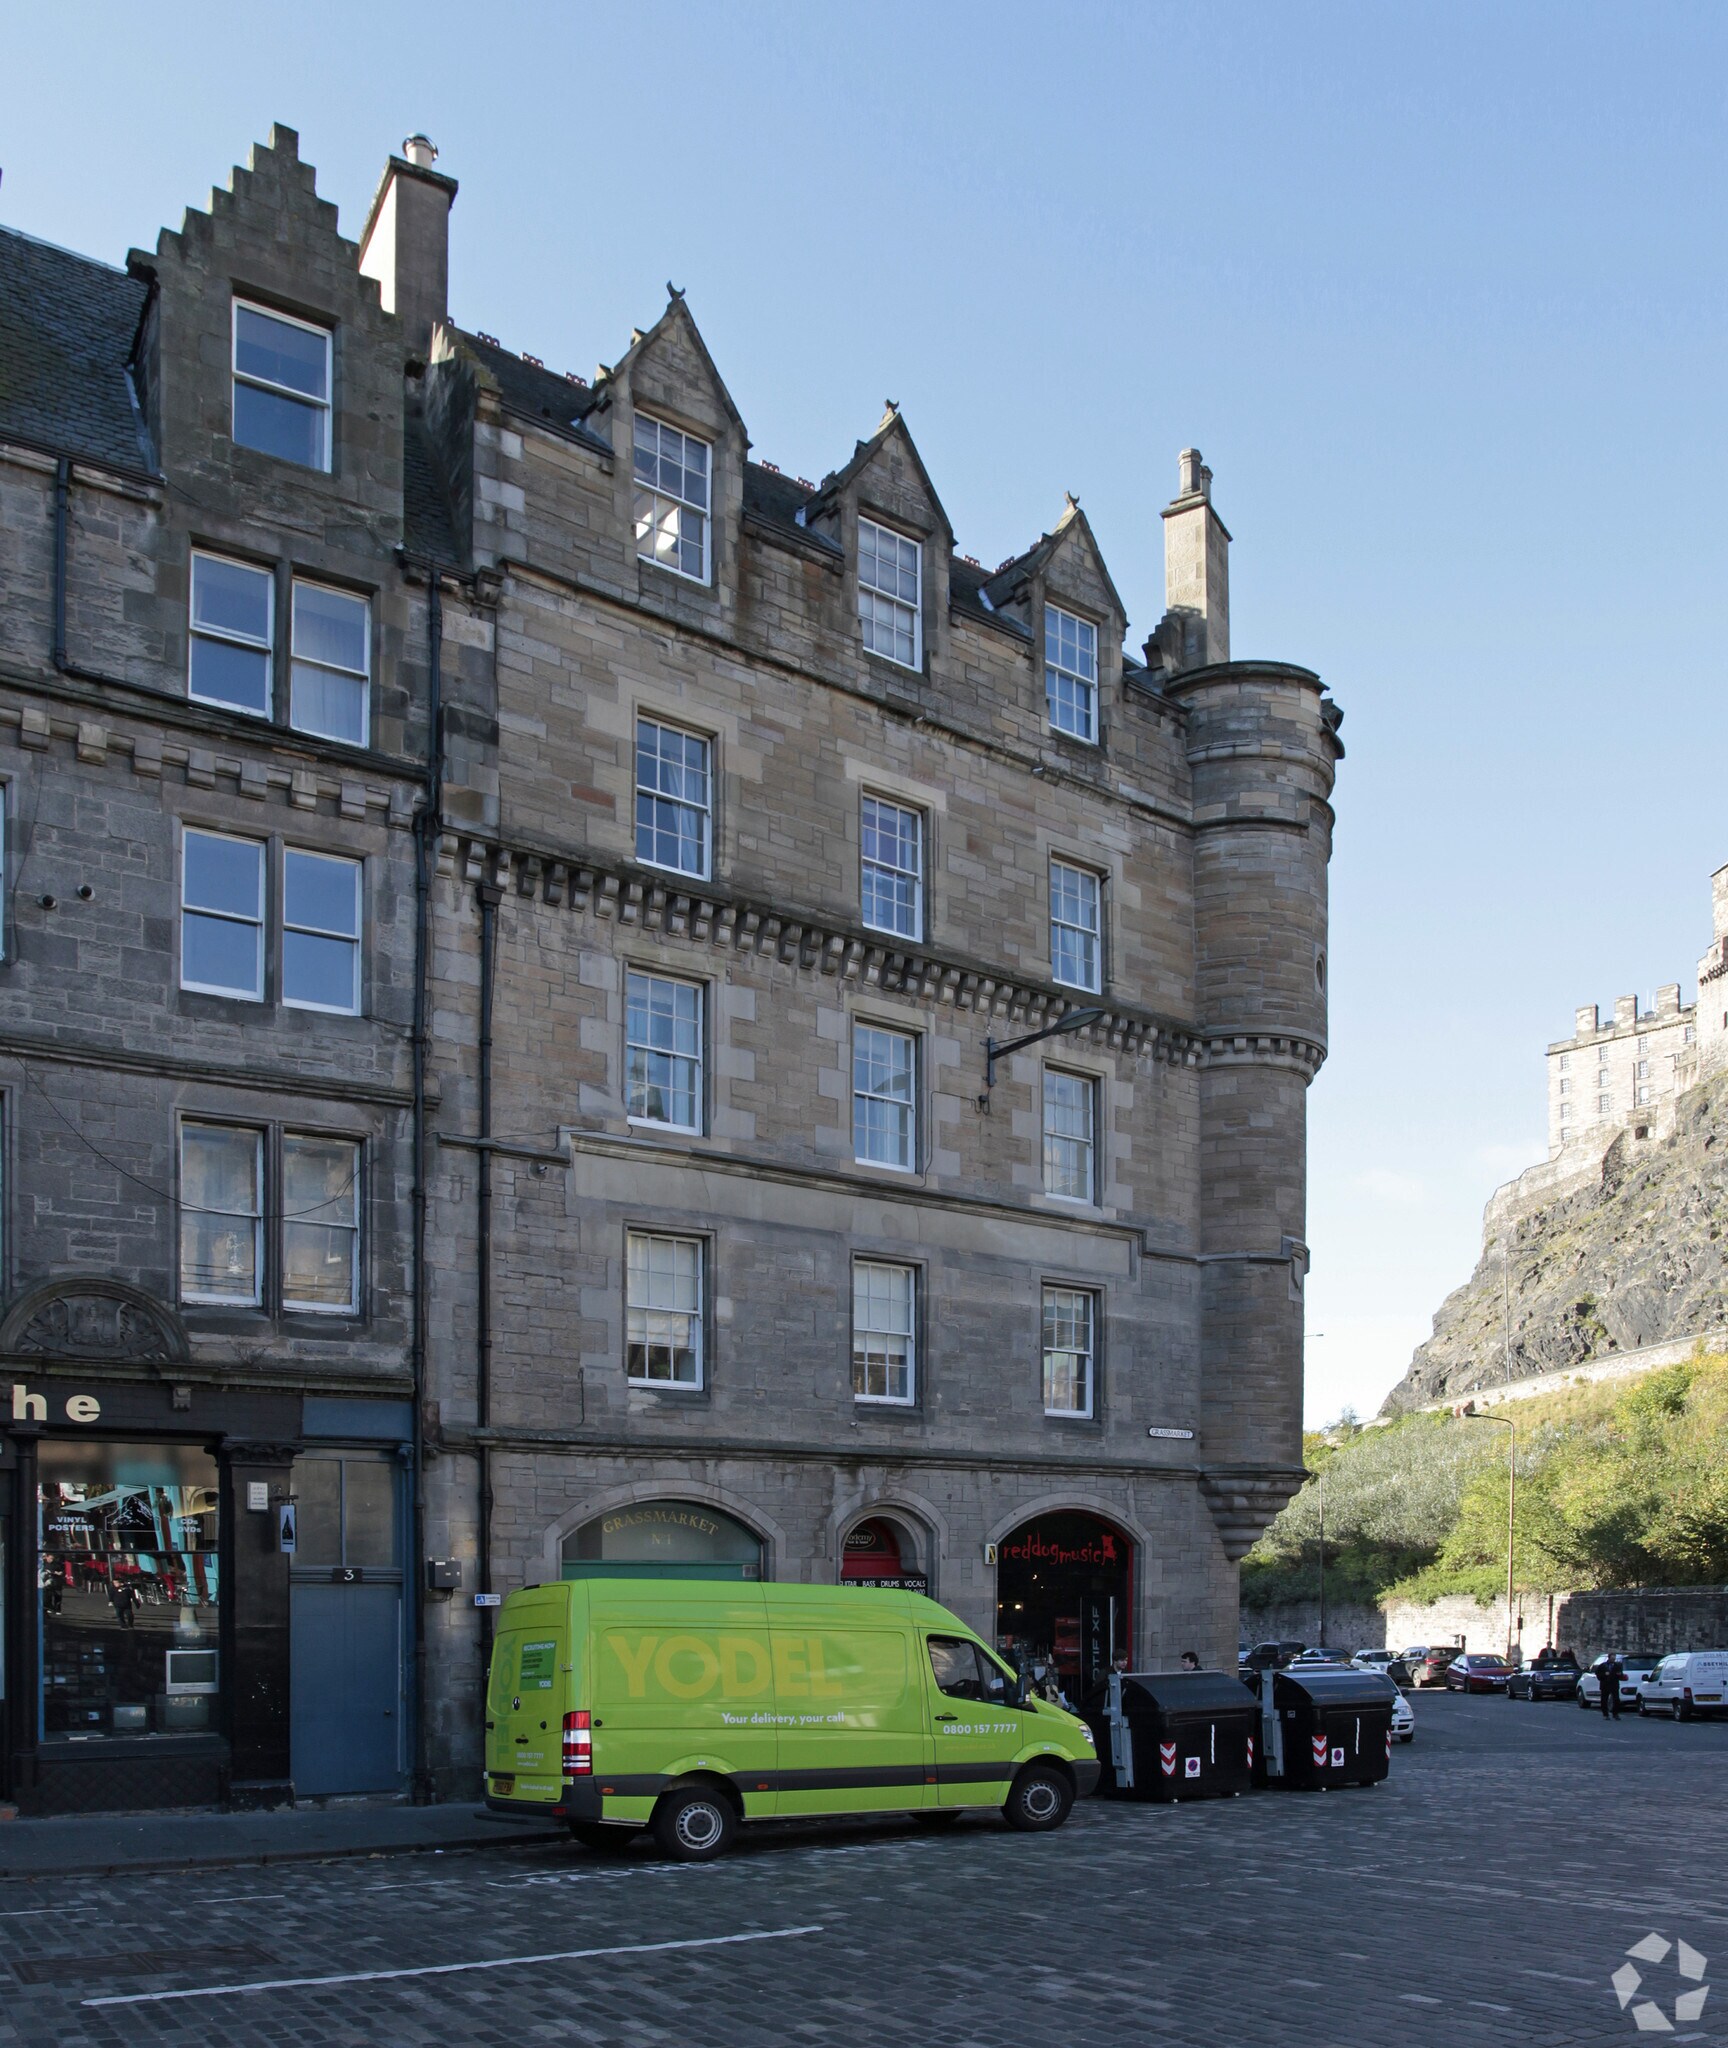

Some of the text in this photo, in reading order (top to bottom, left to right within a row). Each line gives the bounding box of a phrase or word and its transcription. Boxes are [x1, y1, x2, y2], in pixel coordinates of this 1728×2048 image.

[1151, 1429, 1191, 1437] GRASSMARKET
[56, 1516, 88, 1524] VINYL
[603, 1510, 719, 1536] GRASSMARKET
[48, 1524, 95, 1532] POSTERS
[344, 1569, 354, 1581] 3
[904, 1580, 926, 1588] VOCALS
[1092, 1606, 1100, 1632] XF
[607, 1635, 843, 1698] YODEL
[1092, 1638, 1100, 1687] OTIF
[721, 1711, 845, 1726] Your delivery, your call
[943, 1723, 1017, 1734] 0800 157 7777
[485, 1862, 716, 1888] LOADING
